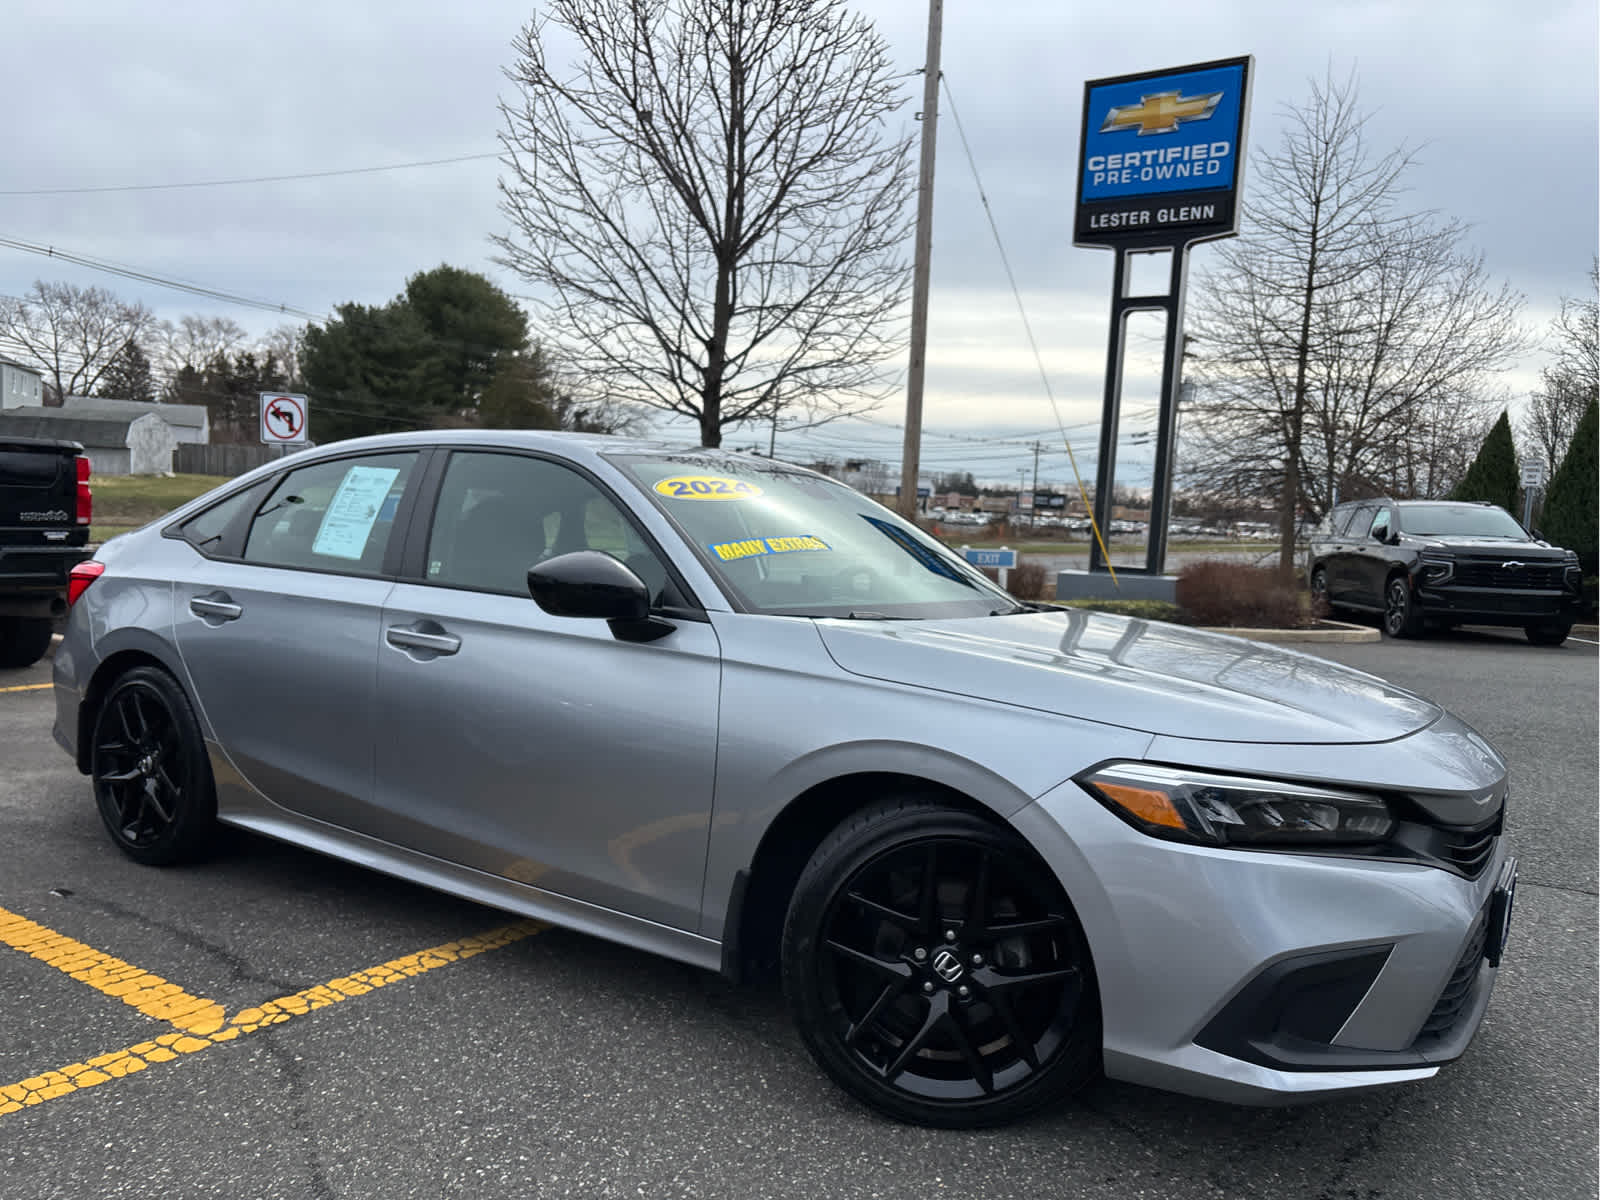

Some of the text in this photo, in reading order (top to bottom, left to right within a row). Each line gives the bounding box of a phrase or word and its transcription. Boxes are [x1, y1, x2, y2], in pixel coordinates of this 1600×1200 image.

[1088, 141, 1230, 171] CERTIFIED
[1093, 160, 1220, 186] PRE-OWNED
[1090, 205, 1215, 228] LESTER GLENN
[668, 481, 753, 496] 2024
[713, 540, 768, 560] MANY
[977, 553, 1000, 564] EXIT
